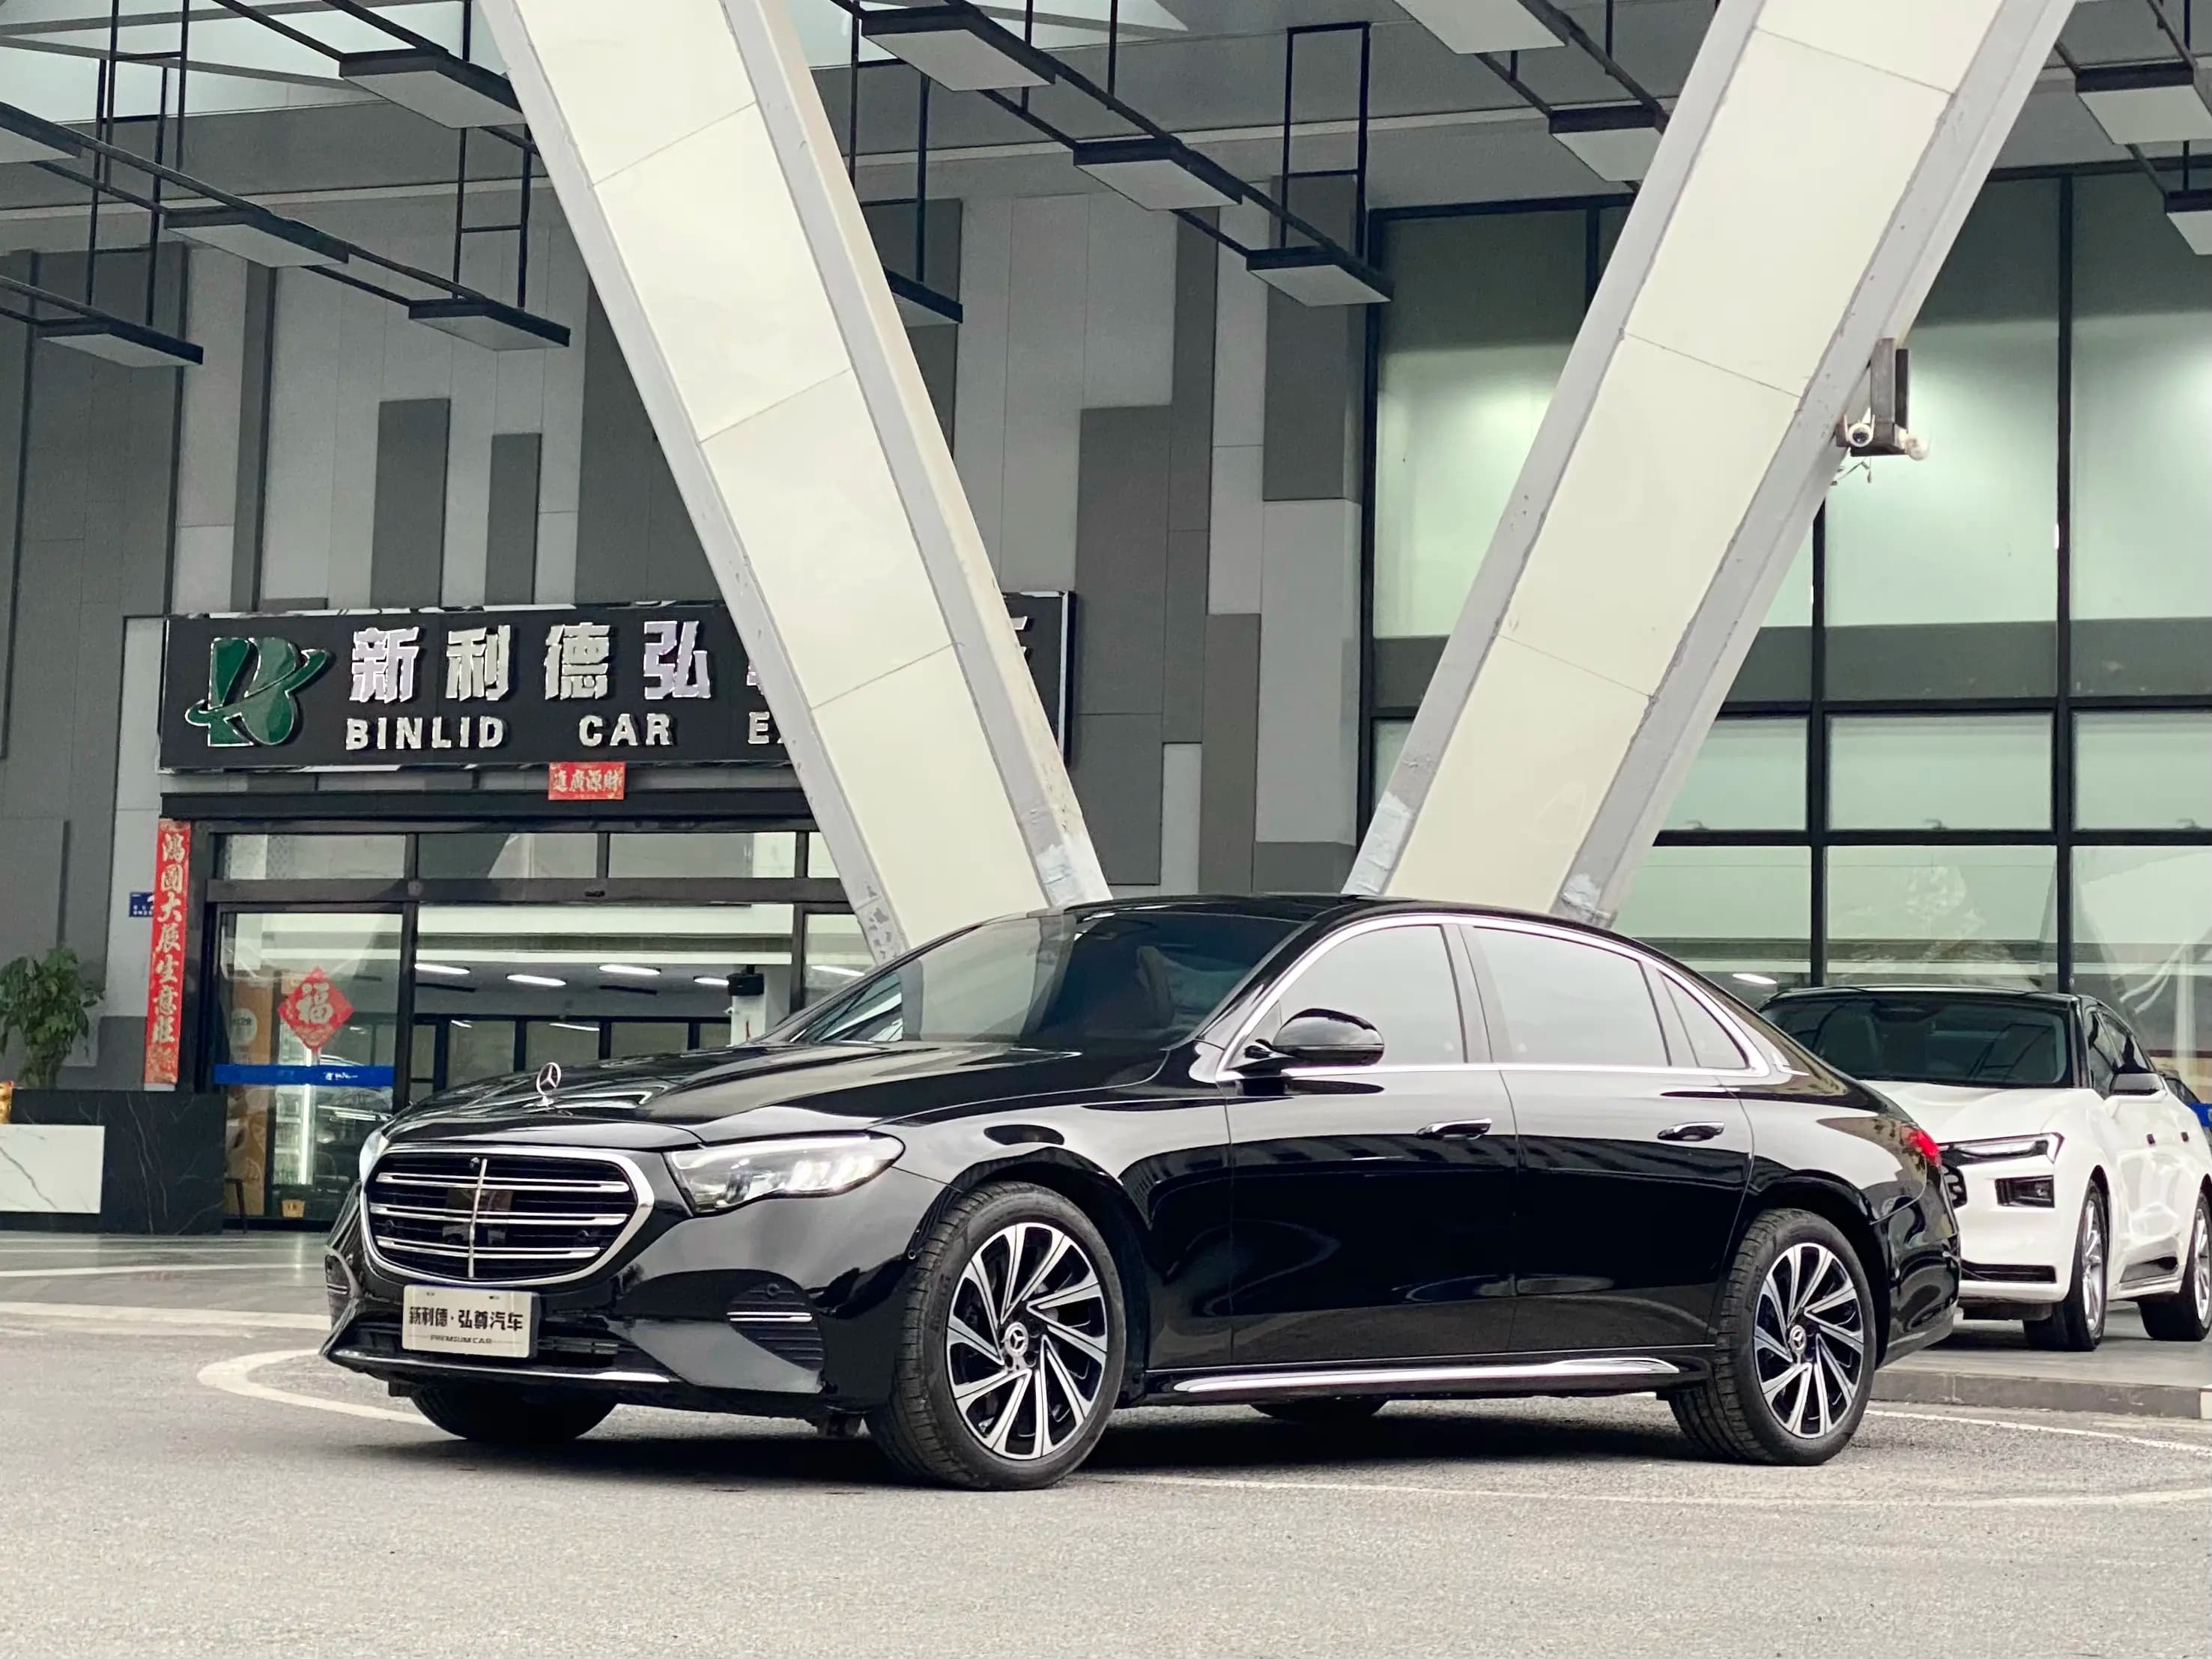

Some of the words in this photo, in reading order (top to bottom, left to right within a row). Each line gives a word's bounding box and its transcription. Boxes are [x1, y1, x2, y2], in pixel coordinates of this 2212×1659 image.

[349, 621, 764, 703] 新利德弘
[345, 715, 504, 750] BINLID
[579, 713, 672, 747] CAR
[748, 712, 784, 744] E
[296, 981, 334, 1024] 福
